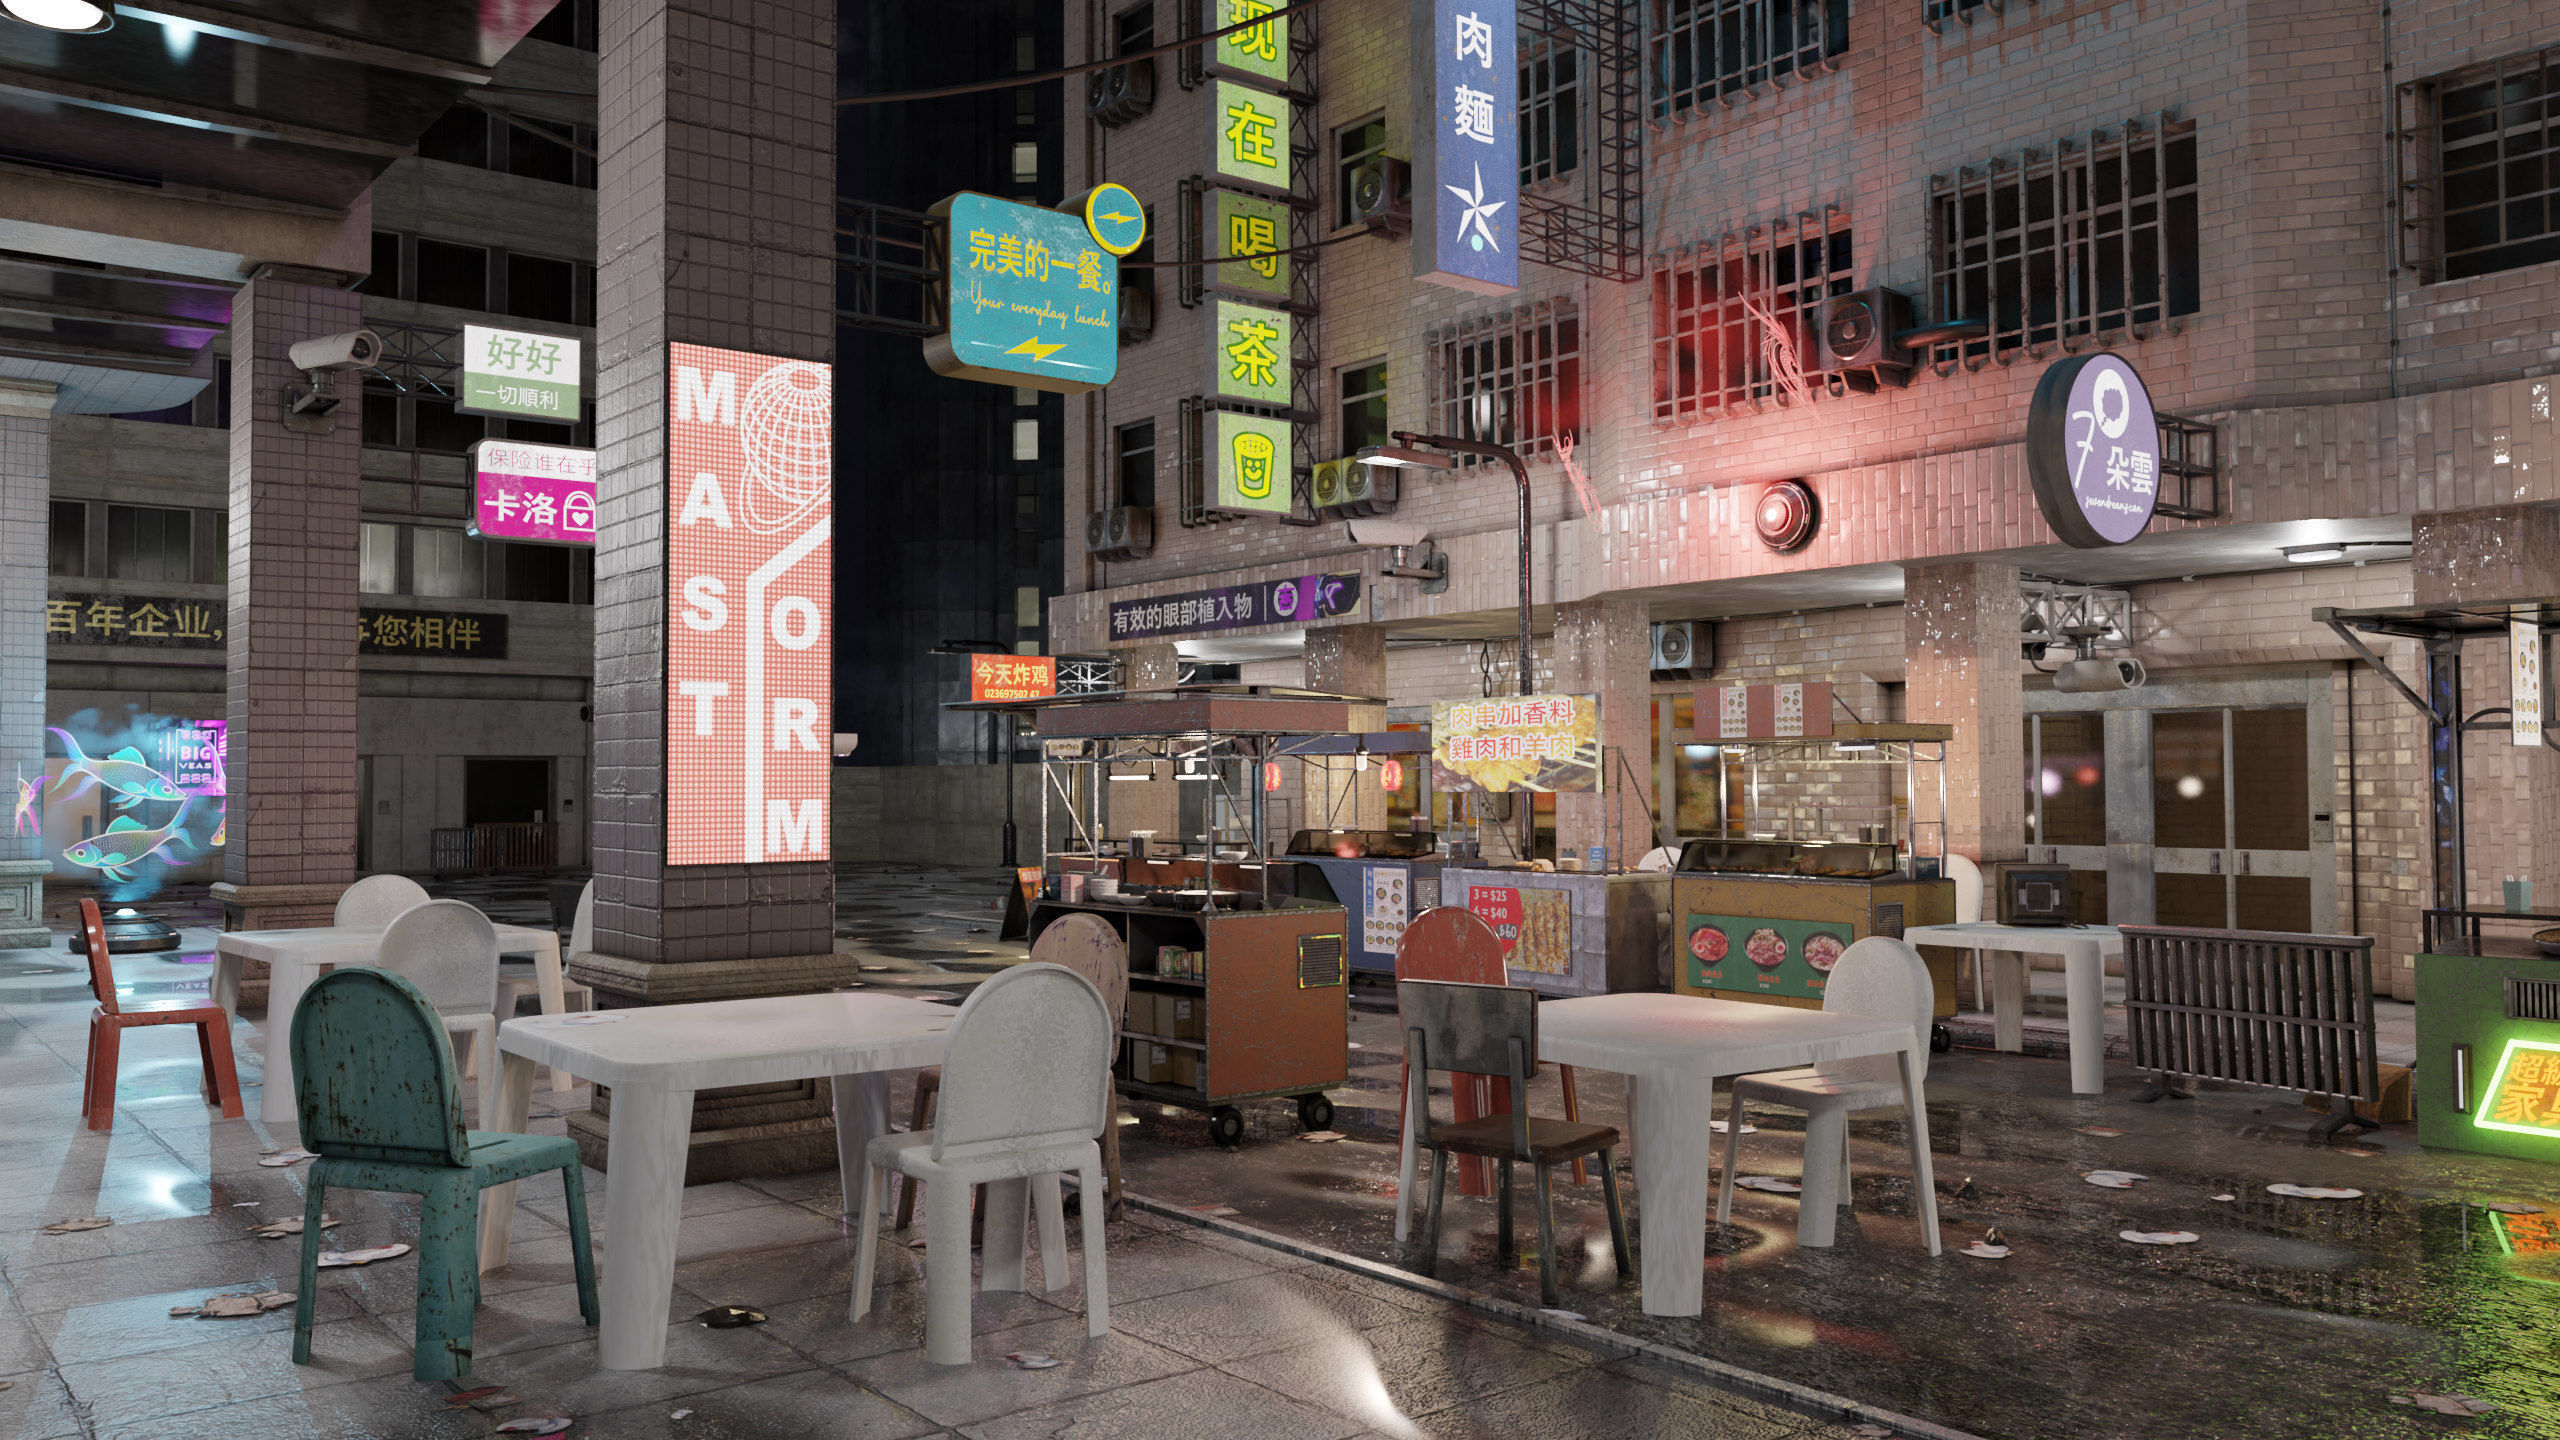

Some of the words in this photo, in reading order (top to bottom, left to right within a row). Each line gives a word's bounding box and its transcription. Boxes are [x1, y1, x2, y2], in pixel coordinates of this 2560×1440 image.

[1455, 11, 1495, 145] 肉麵
[969, 227, 1111, 295] 完美的一餐。
[970, 279, 1005, 315] Your
[1011, 300, 1069, 330] everyday
[1074, 305, 1111, 328] lunch
[487, 333, 562, 376] 好好
[475, 384, 560, 411] 一切順利
[2106, 445, 2154, 496] 朵雲
[483, 488, 558, 526] 卡洛
[1113, 592, 1253, 635] 有效的眼部植入物
[976, 661, 1049, 687] 今天炸鸡
[1451, 699, 1575, 729] 肉串加香料
[180, 745, 212, 761] BIG
[1450, 733, 1574, 760] 雞肉和羊肉
[1473, 888, 1480, 901] 3
[1490, 889, 1507, 903] $25
[1490, 907, 1508, 920] $40
